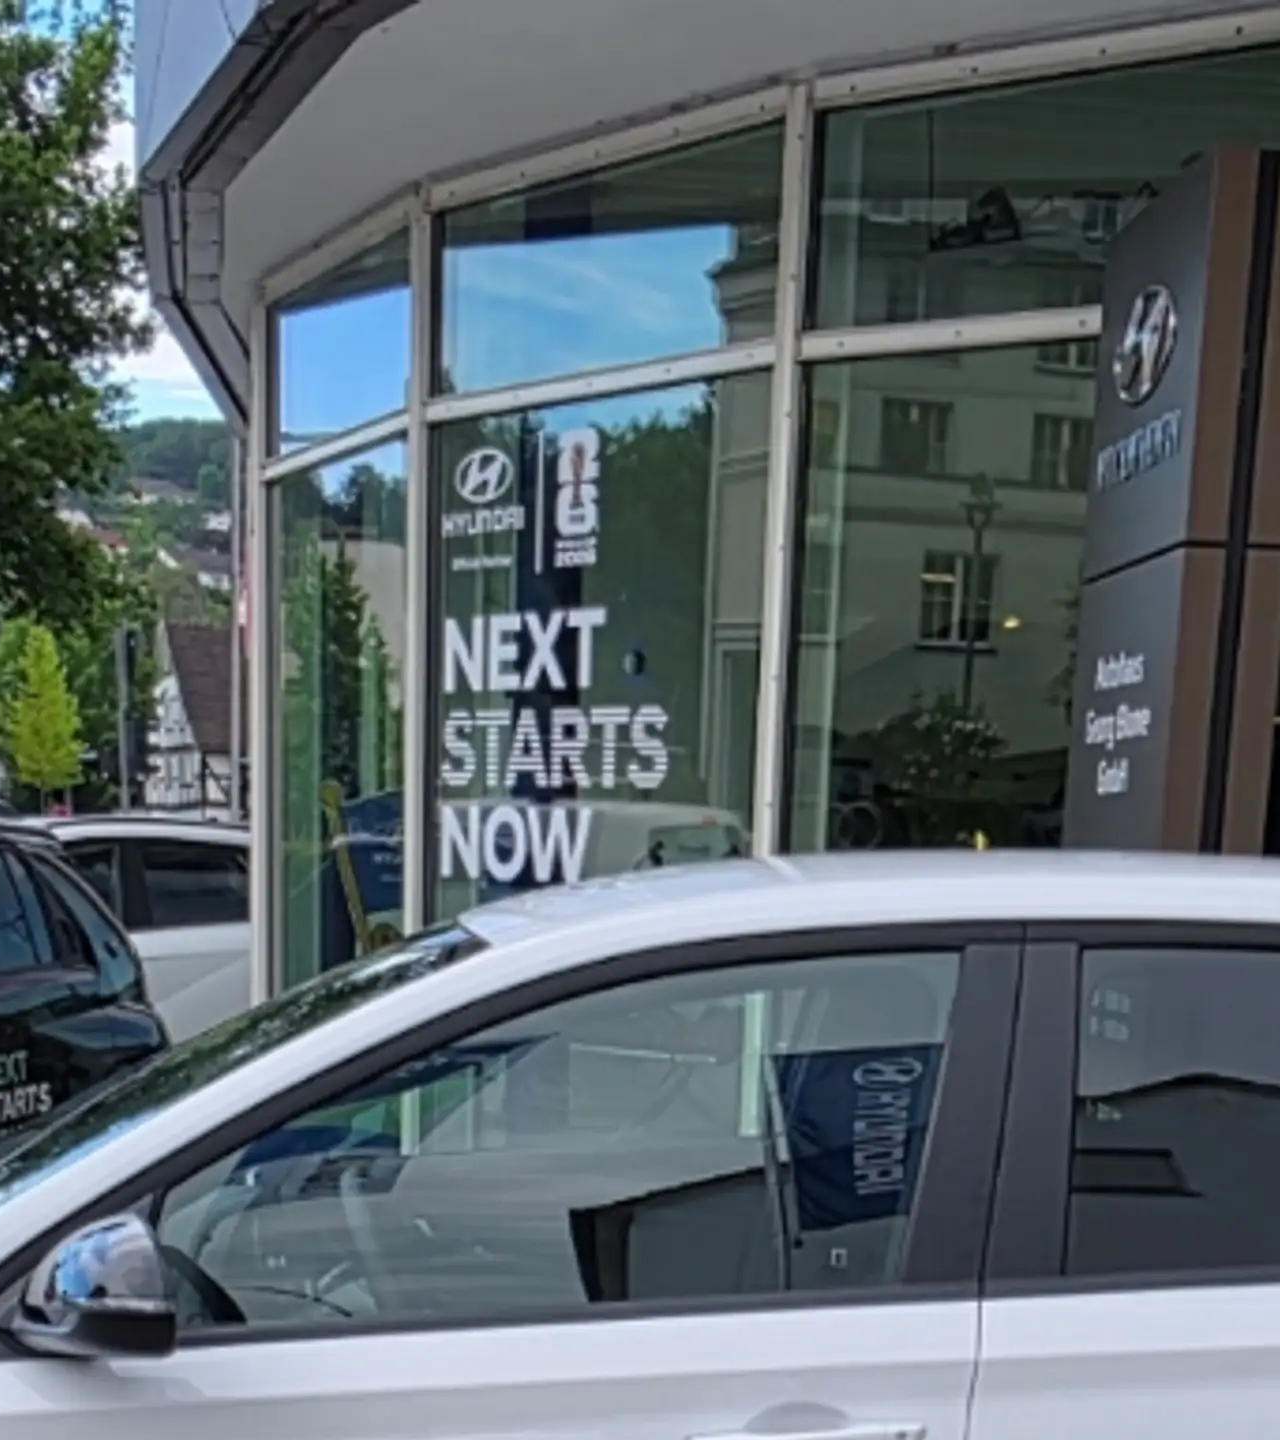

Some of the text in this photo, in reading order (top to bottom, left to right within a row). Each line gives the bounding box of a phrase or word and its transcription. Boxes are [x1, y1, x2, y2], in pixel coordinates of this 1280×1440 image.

[441, 505, 525, 538] HYUNDAI
[444, 607, 607, 693] NEXT
[440, 705, 669, 790] STARTS
[440, 803, 592, 884] NOW
